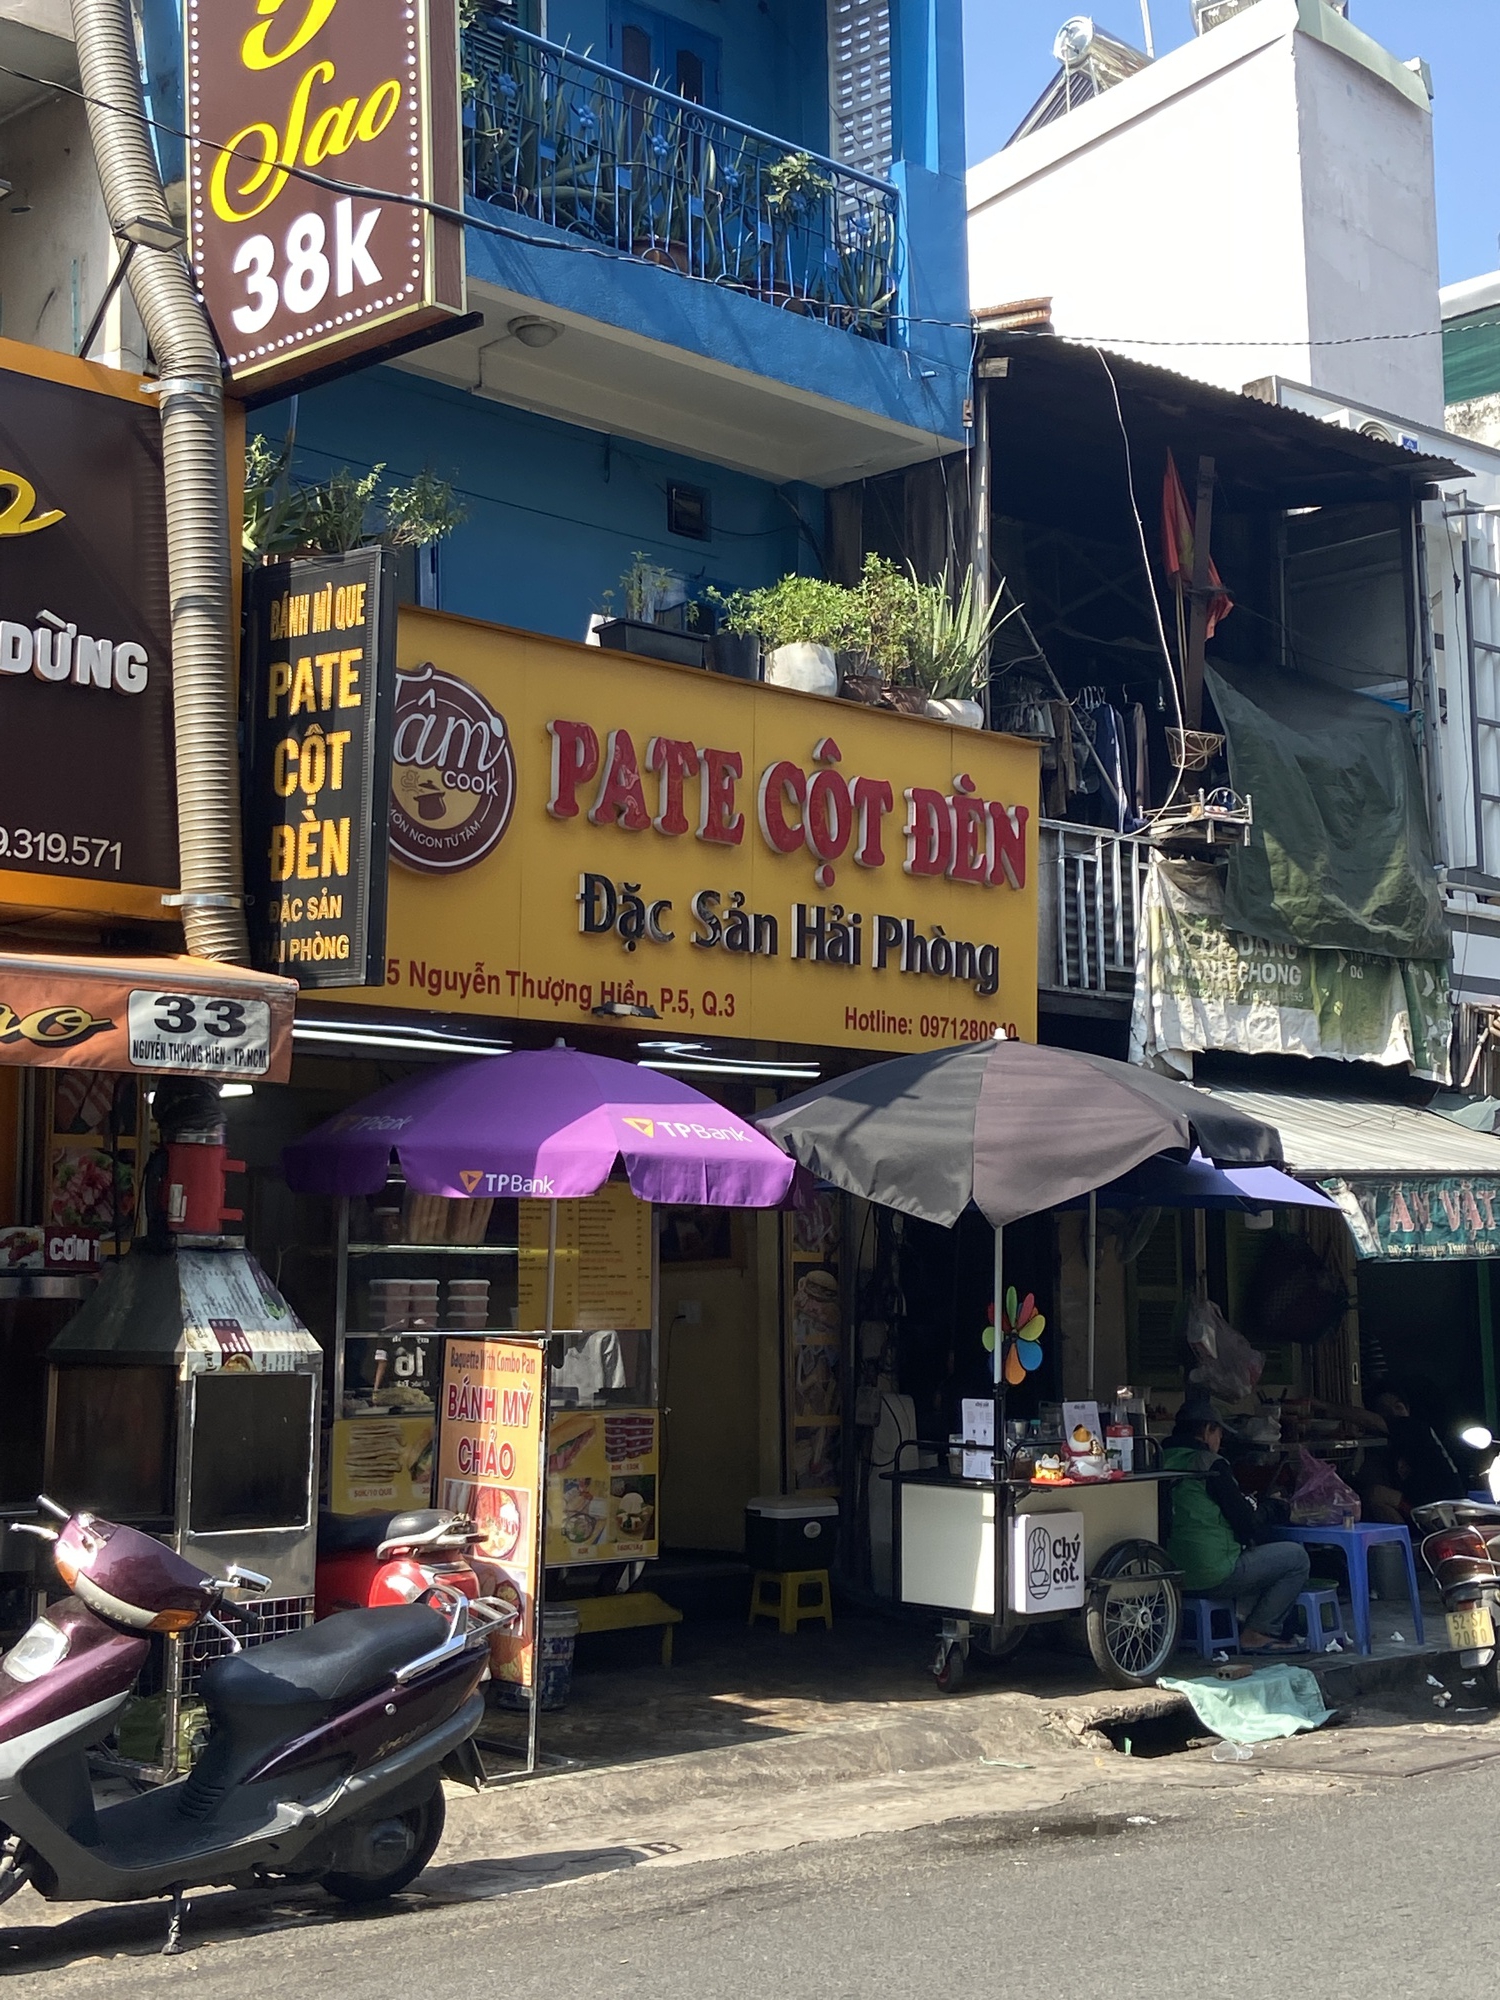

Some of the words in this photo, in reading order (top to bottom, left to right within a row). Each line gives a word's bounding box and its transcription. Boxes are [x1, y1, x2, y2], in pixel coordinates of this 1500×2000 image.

[210, 60, 401, 223] Sao
[270, 590, 310, 641] BÁNH
[312, 581, 333, 634] MÌ
[334, 582, 367, 632] QUE
[0, 608, 149, 694] DỪNG
[267, 647, 362, 720] PATE
[273, 722, 352, 806] CỘT
[547, 719, 745, 846] PATE
[758, 737, 894, 888] CỘT
[902, 773, 1030, 891] ĐÈN
[267, 809, 351, 882] ĐÈN
[408, 828, 443, 849] NGON
[269, 892, 303, 928] ĐẶC
[306, 886, 342, 921] SẢN
[288, 930, 350, 963] PHÒNG
[576, 872, 675, 953] Đặc
[690, 889, 778, 955] Sản
[791, 903, 862, 966] Hải
[872, 914, 1000, 997] Phòng
[409, 959, 500, 999] Nguyễn
[505, 970, 593, 1008] Thượng
[660, 987, 696, 1017] P.5,
[702, 990, 736, 1018] Q.3
[153, 995, 247, 1038] 33
[845, 1006, 913, 1035] Hotline:
[234, 1048, 267, 1068] TP.HCM
[656, 1121, 753, 1143] TPBank
[485, 1173, 555, 1194] TPBank
[49, 1234, 90, 1262] CƠM
[450, 1346, 480, 1374] Baguette
[496, 1350, 520, 1374] Combo
[521, 1352, 536, 1375] Pan
[447, 1374, 497, 1425] BÁNH
[501, 1379, 534, 1428] MỲ
[457, 1427, 516, 1480] CHẢO
[379, 1487, 393, 1497] QUE
[1052, 1532, 1081, 1563] Chý
